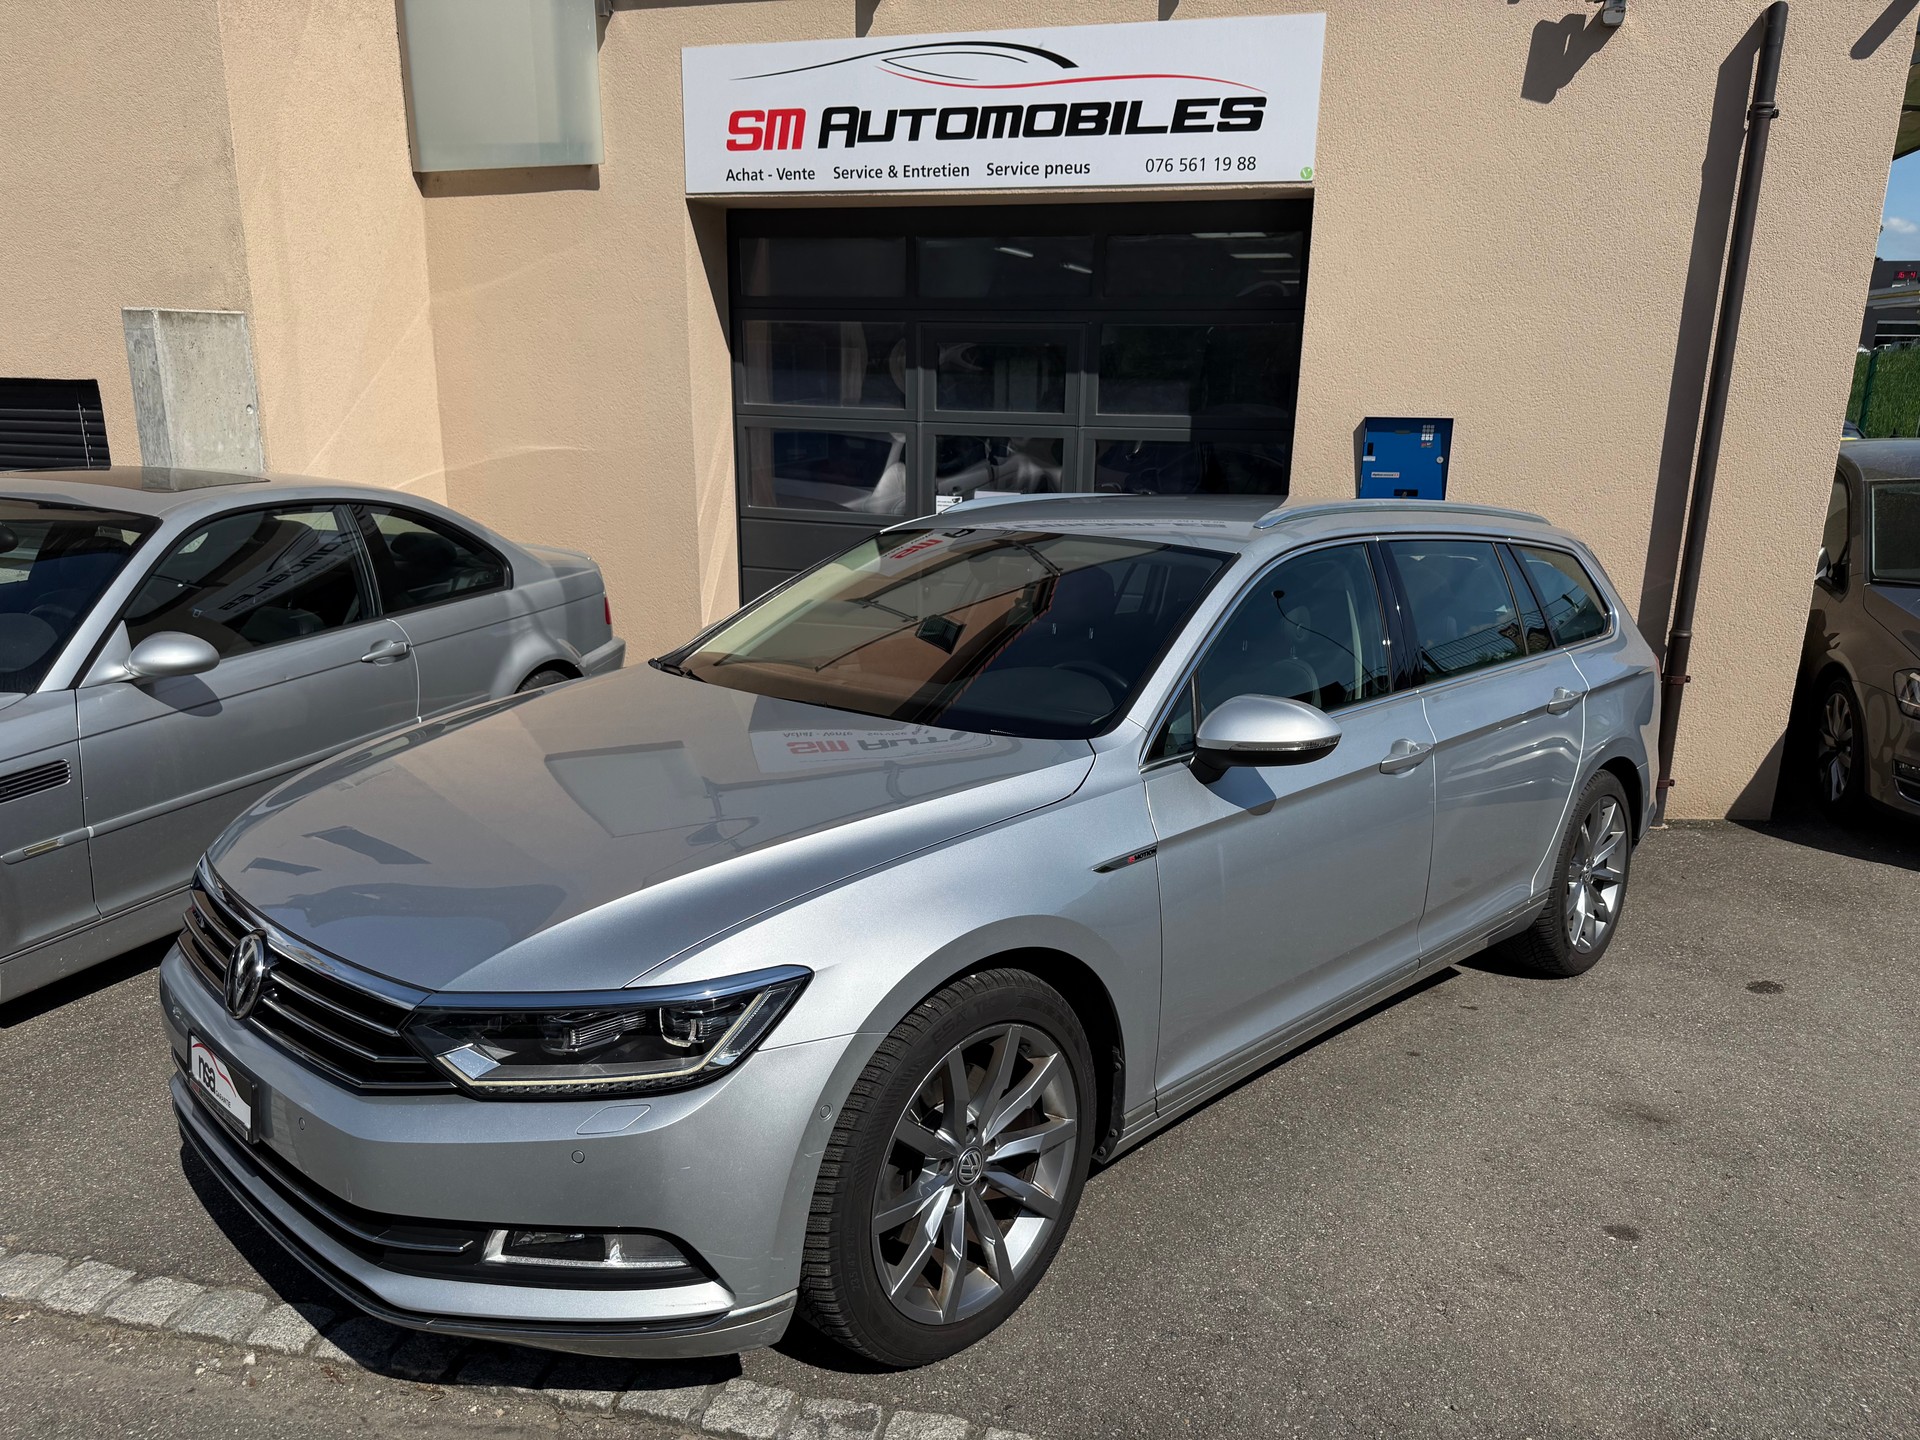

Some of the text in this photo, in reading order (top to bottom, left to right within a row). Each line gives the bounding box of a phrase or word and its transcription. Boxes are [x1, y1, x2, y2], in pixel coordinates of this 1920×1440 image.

[726, 96, 1268, 152] SM AUTOMOBILES
[833, 162, 970, 180] Service & Entretien
[986, 162, 1091, 179] Service pneus
[1145, 156, 1257, 173] 076 561 19 88
[725, 168, 764, 182] Achat
[776, 167, 816, 181] Vente
[198, 1055, 216, 1095] nsa
